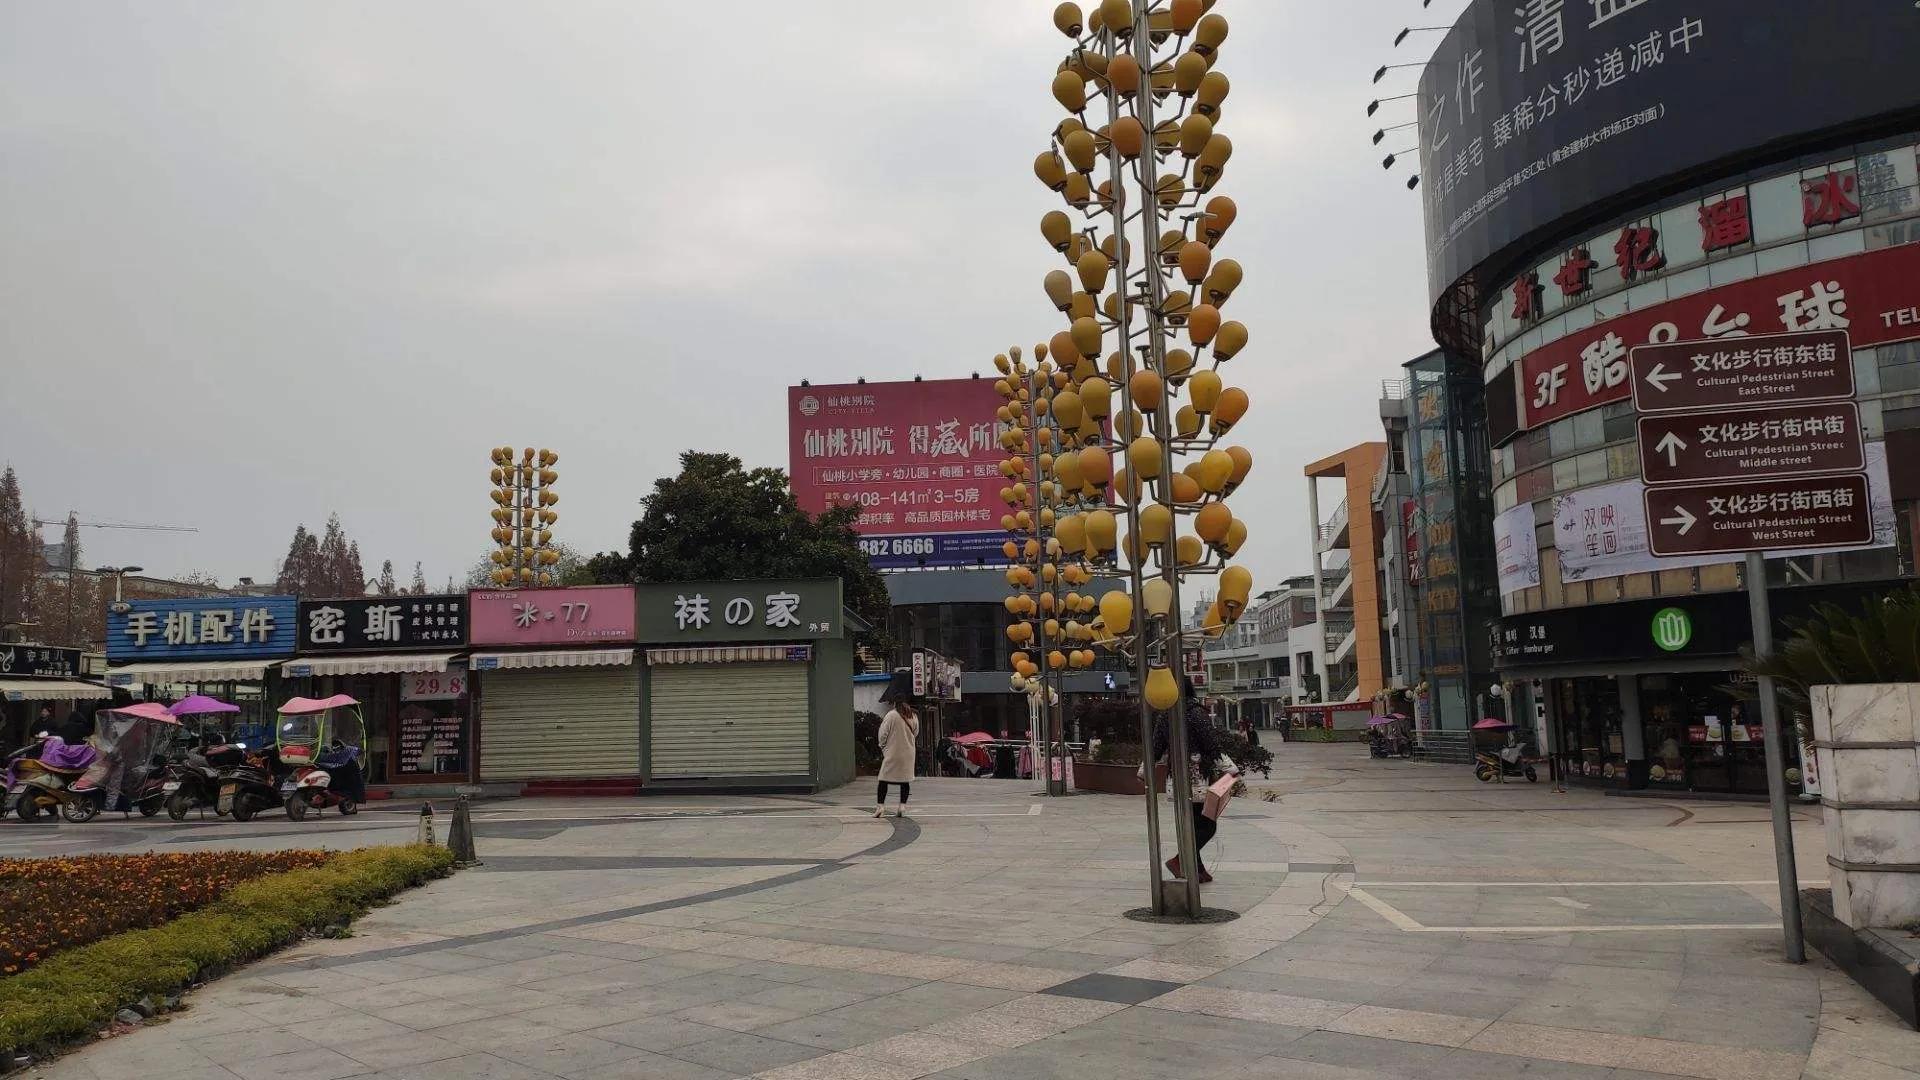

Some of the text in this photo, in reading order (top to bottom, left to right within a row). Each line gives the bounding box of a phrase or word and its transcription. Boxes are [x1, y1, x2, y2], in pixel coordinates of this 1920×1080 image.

[1493, 17, 1703, 149] 臻稀分秒递减中
[1880, 307, 1920, 328] TEL
[1690, 343, 1836, 372] 文化步行街东街
[1533, 362, 1568, 409] 3F
[1697, 368, 1835, 387] Cultural Pedestrian Street
[1738, 384, 1796, 396] East Street
[828, 394, 876, 406] 仙桃别院
[1699, 415, 1845, 444] 文化步行街中街
[803, 426, 895, 458] 仙桃别院
[1705, 447, 1748, 458] Cultural
[1750, 443, 1808, 455] Pedestrian
[1739, 455, 1812, 469] Middle street
[1706, 488, 1853, 516] 文化步行街西街
[854, 512, 895, 526] 容积率
[1713, 513, 1852, 531] Cultural Pedestrian Street
[1752, 527, 1815, 541] West Street
[893, 537, 934, 555] 6666
[674, 591, 801, 630] 袜の家
[124, 608, 276, 646] 手机配件
[309, 605, 404, 643] 密斯
[412, 616, 459, 626] 皮肤管理
[808, 622, 830, 632] 外贸
[416, 677, 462, 695] 29.8
